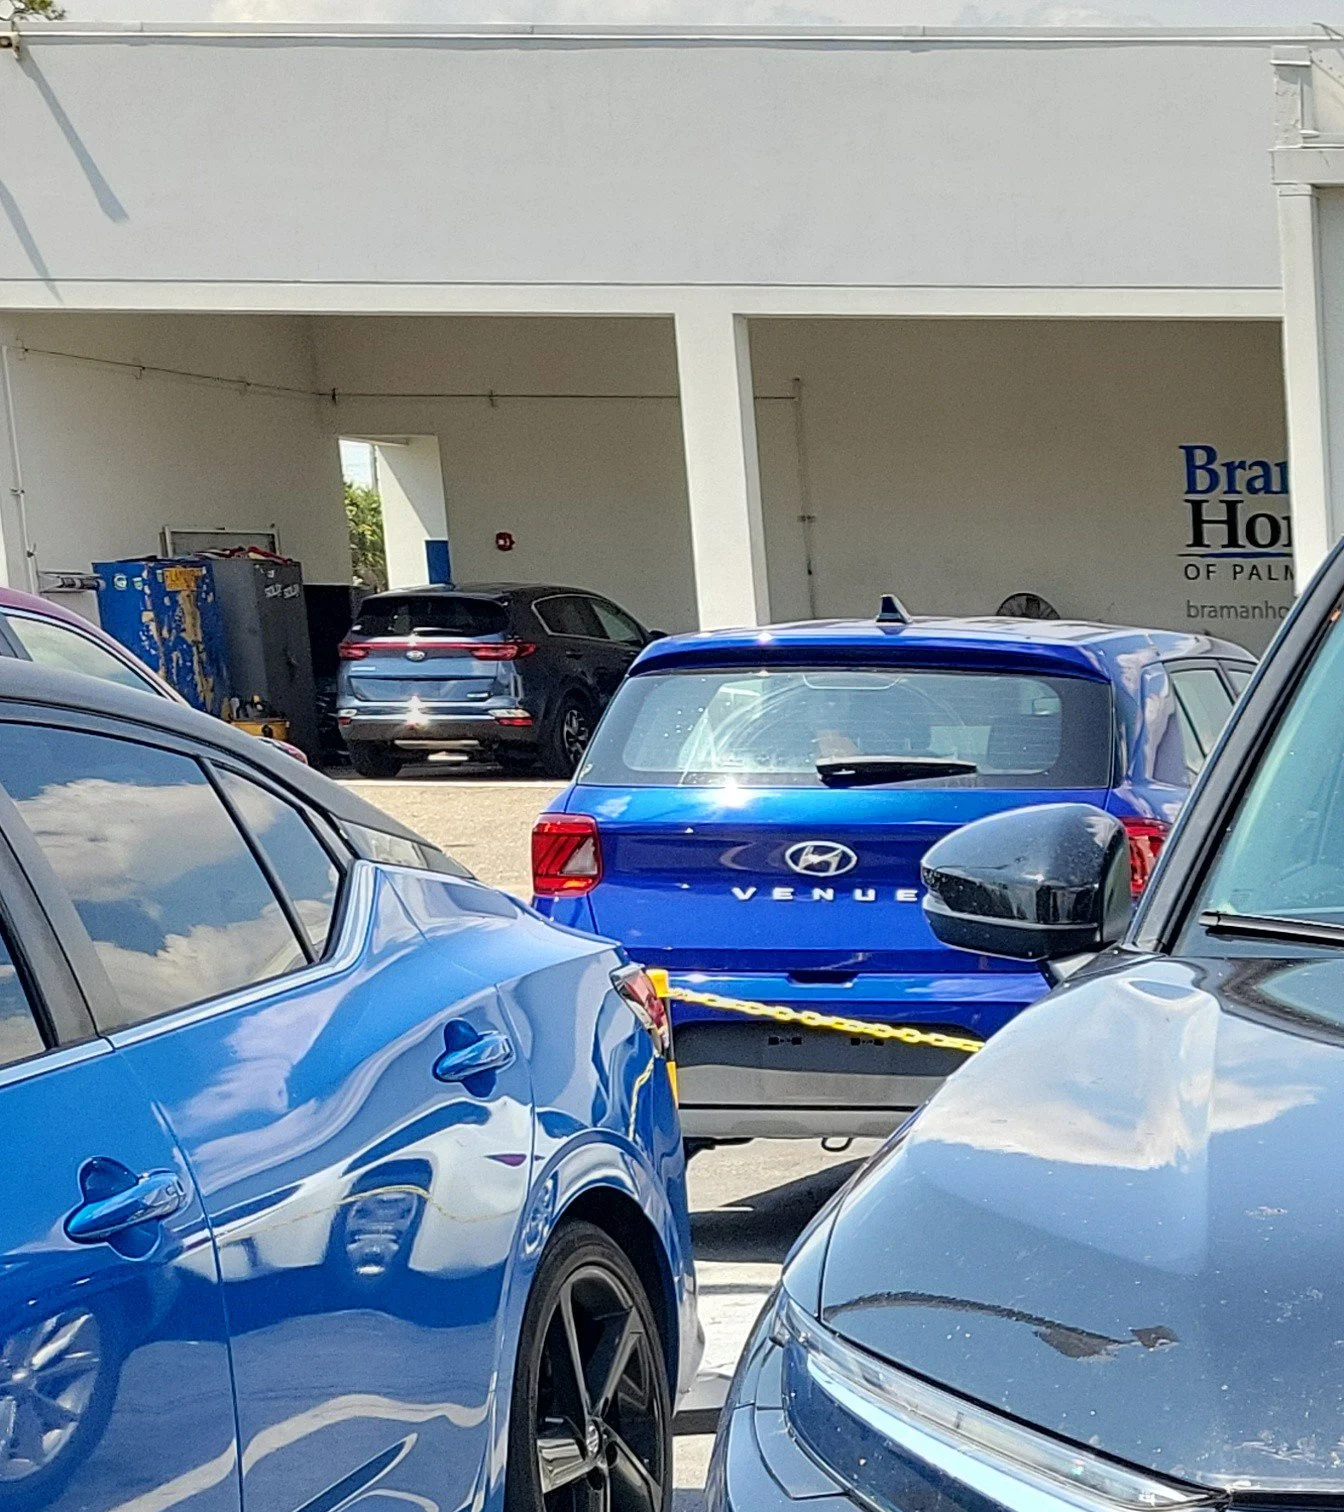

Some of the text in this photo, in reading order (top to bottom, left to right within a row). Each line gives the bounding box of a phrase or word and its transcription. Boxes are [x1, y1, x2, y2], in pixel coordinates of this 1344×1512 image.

[1184, 498, 1292, 549] Ho
[1184, 563, 1218, 581] OF
[731, 886, 919, 902] VENUE
